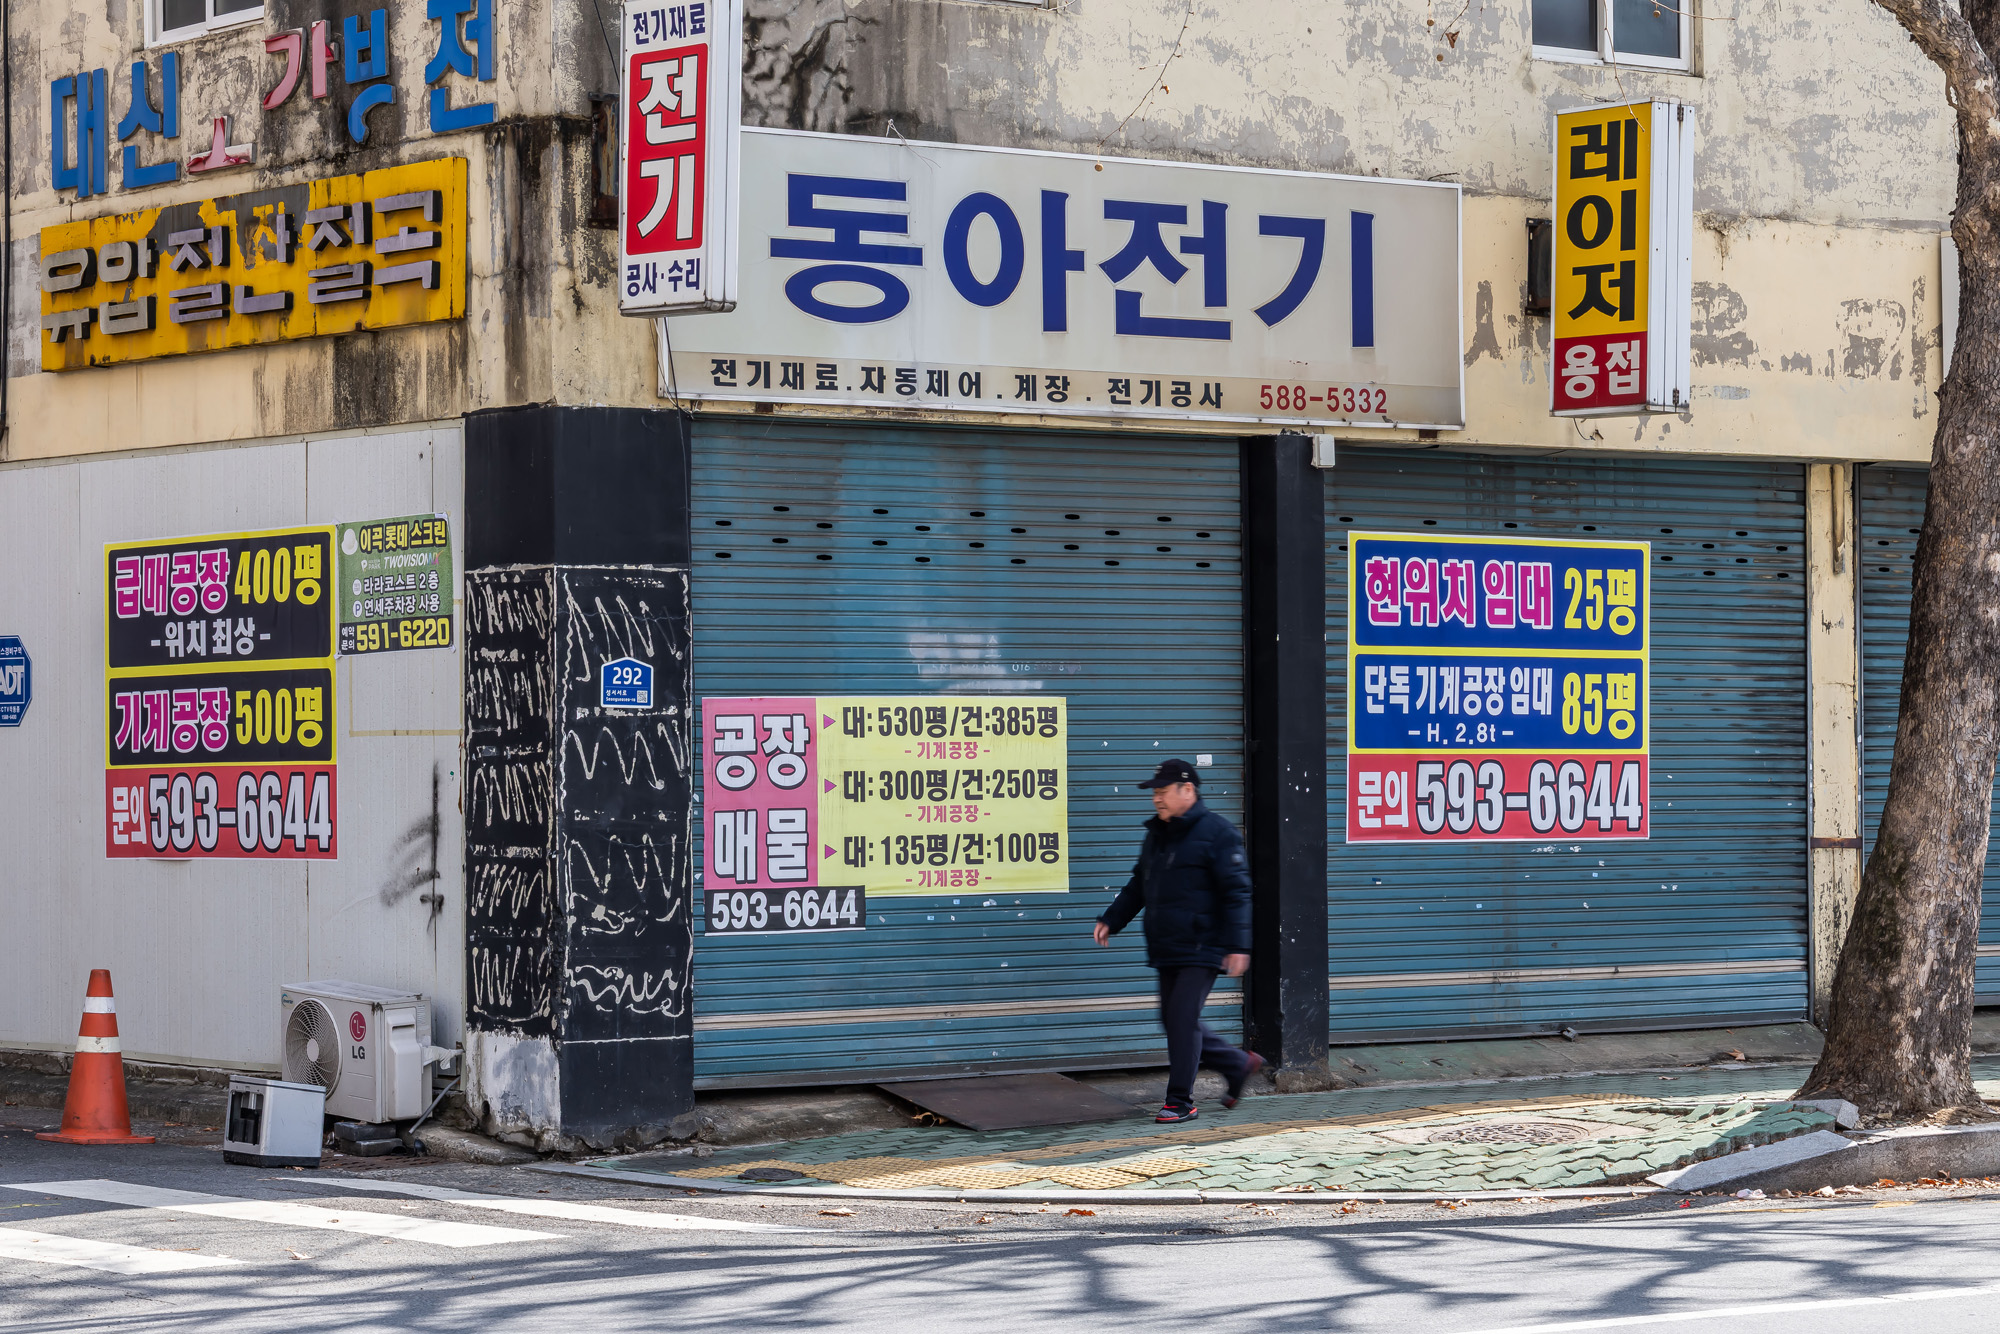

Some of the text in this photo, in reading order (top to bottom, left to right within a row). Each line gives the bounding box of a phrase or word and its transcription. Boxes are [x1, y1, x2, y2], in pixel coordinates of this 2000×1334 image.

[633, 3, 706, 45] 전기재료
[637, 54, 698, 240] 전기
[1566, 119, 1638, 322] 레이저
[770, 172, 1375, 348] 동아전기
[1260, 384, 1388, 413] 588-5332
[1561, 340, 1640, 399] 용접
[115, 544, 322, 619] 급매공장 400평
[363, 573, 417, 596] 라라코스트
[364, 593, 440, 617] 연세주차장 사용
[1365, 556, 1636, 636] 현위치 임대 25평
[356, 618, 450, 652] 591-6220
[612, 667, 642, 685] 292
[1365, 665, 1636, 740] 단독 기계공장 임대 85평
[115, 686, 323, 753] 기계공장 500평
[713, 713, 811, 791] 공장
[113, 772, 332, 852] 문의 593-6644
[1358, 760, 1643, 834] 문의 593-6644
[713, 808, 809, 884] 매물
[711, 889, 858, 929] 593-6644
[352, 1045, 366, 1060] LG
